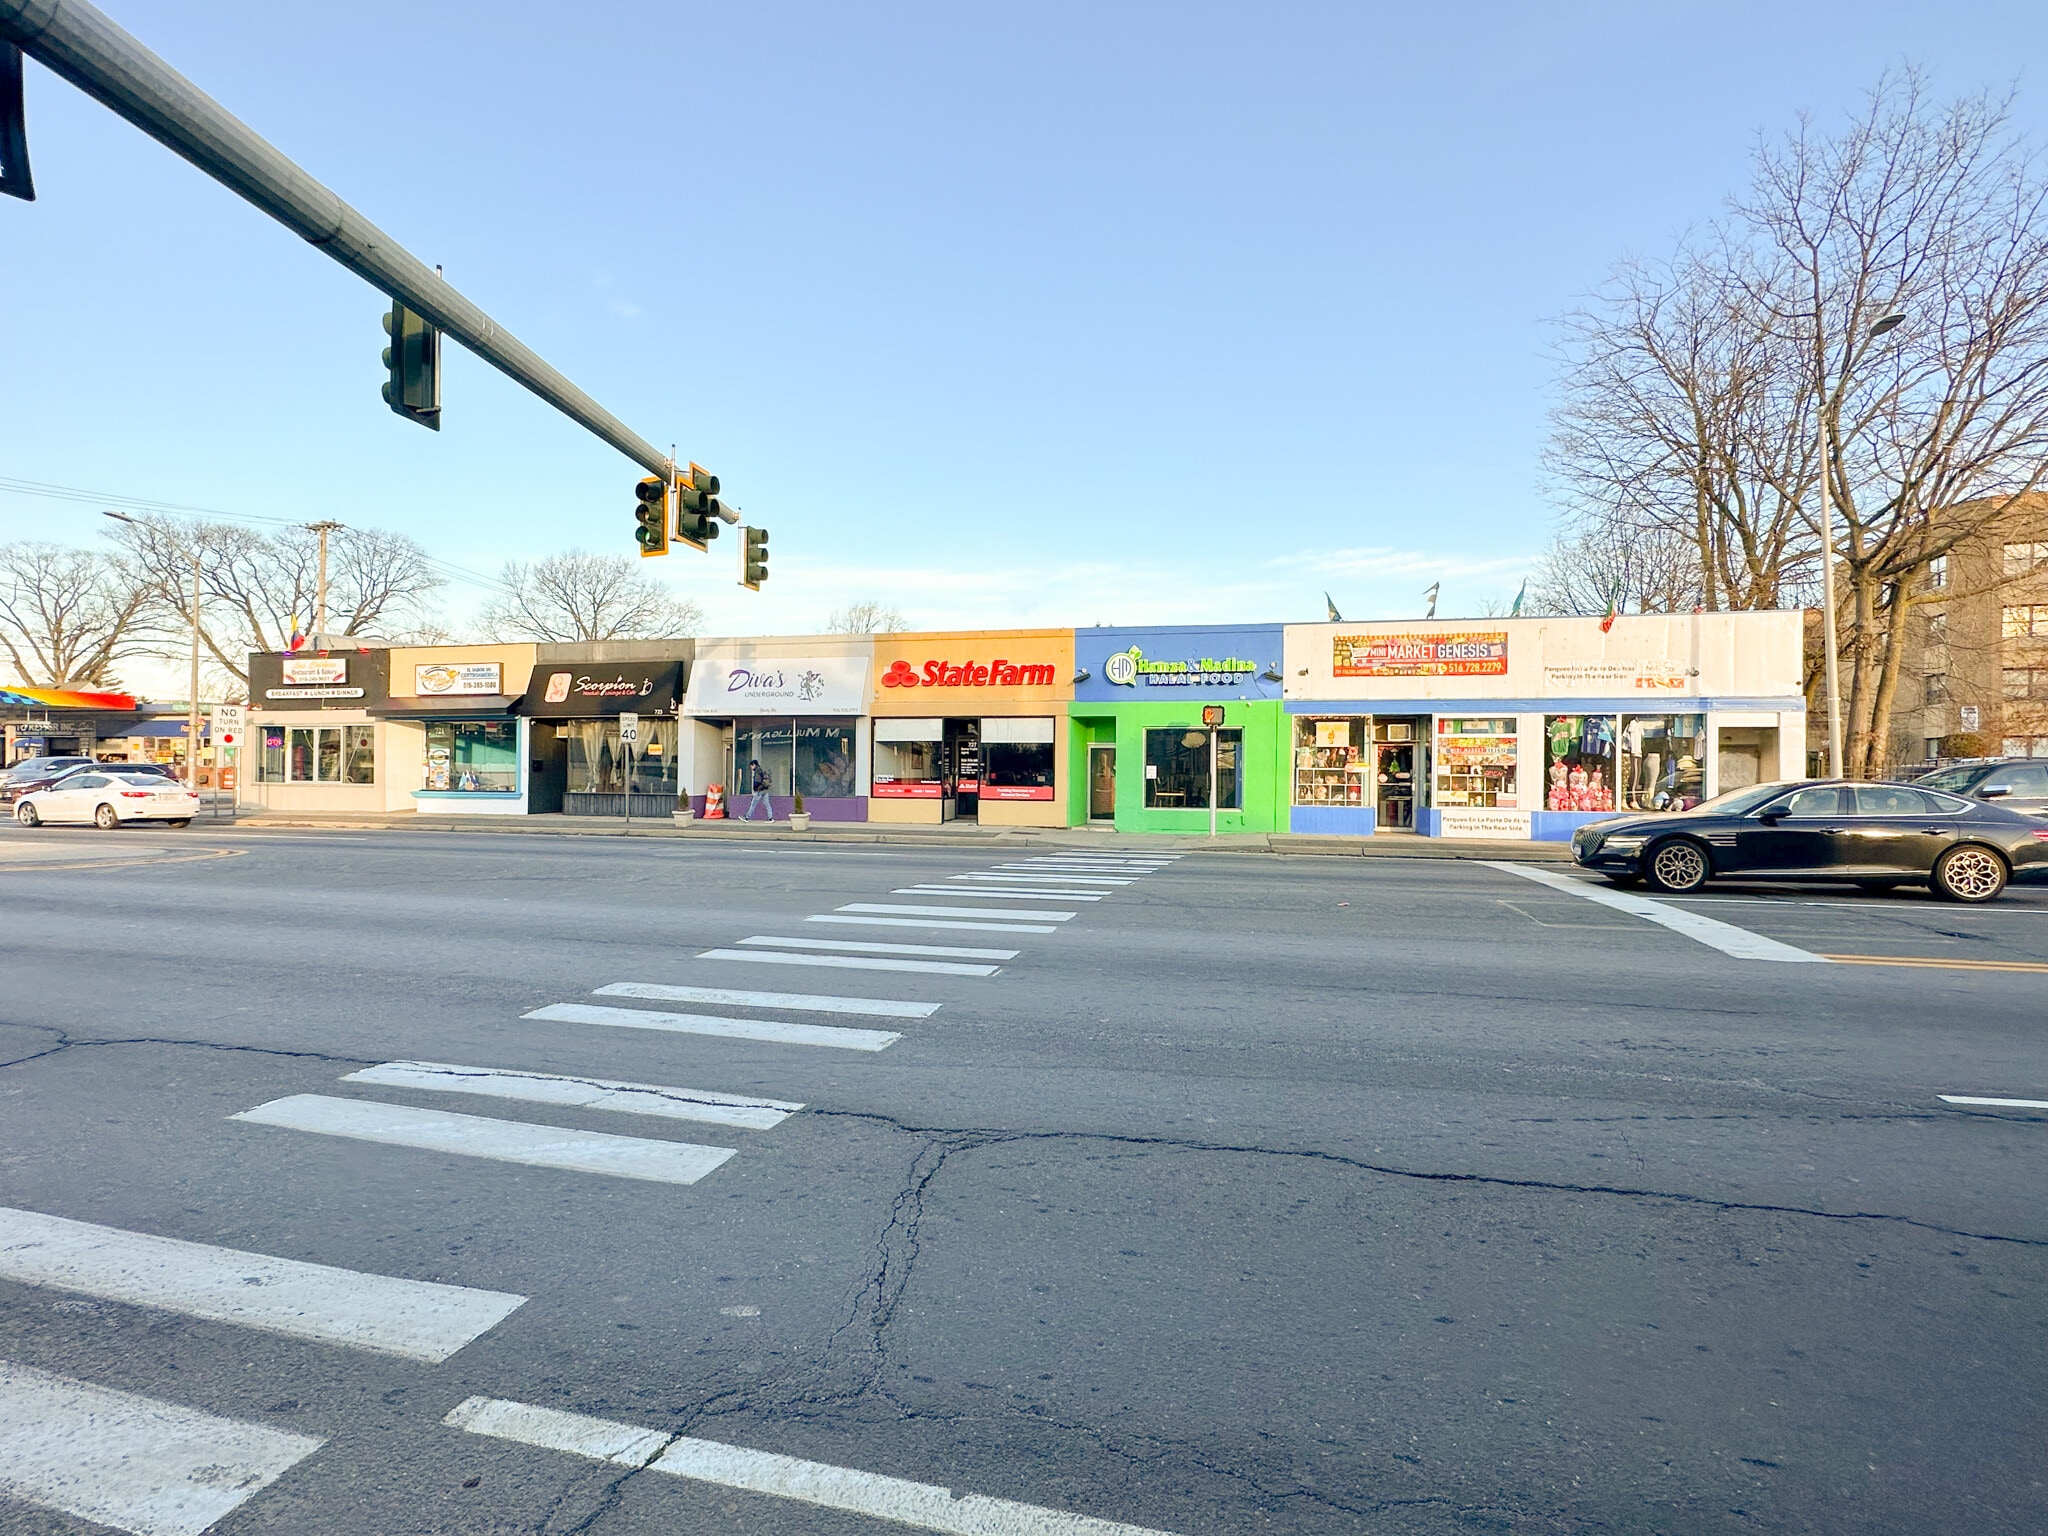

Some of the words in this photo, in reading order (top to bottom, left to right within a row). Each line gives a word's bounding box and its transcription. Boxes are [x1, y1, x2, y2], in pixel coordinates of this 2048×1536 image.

[1370, 647, 1386, 657] MINI
[1387, 645, 1436, 660] MARKET
[1437, 644, 1488, 658] GENESIS
[1139, 658, 1186, 673] Hamza
[1200, 657, 1255, 673] Madina
[1449, 661, 1502, 672] 516.728.2279
[727, 669, 787, 692] Diva's
[1149, 673, 1195, 685] HALAL
[1201, 673, 1244, 685] FOOD
[574, 675, 637, 696] Scorpion
[221, 708, 237, 717] NO
[622, 729, 637, 740] 40
[1484, 769, 1504, 777] OPEN
